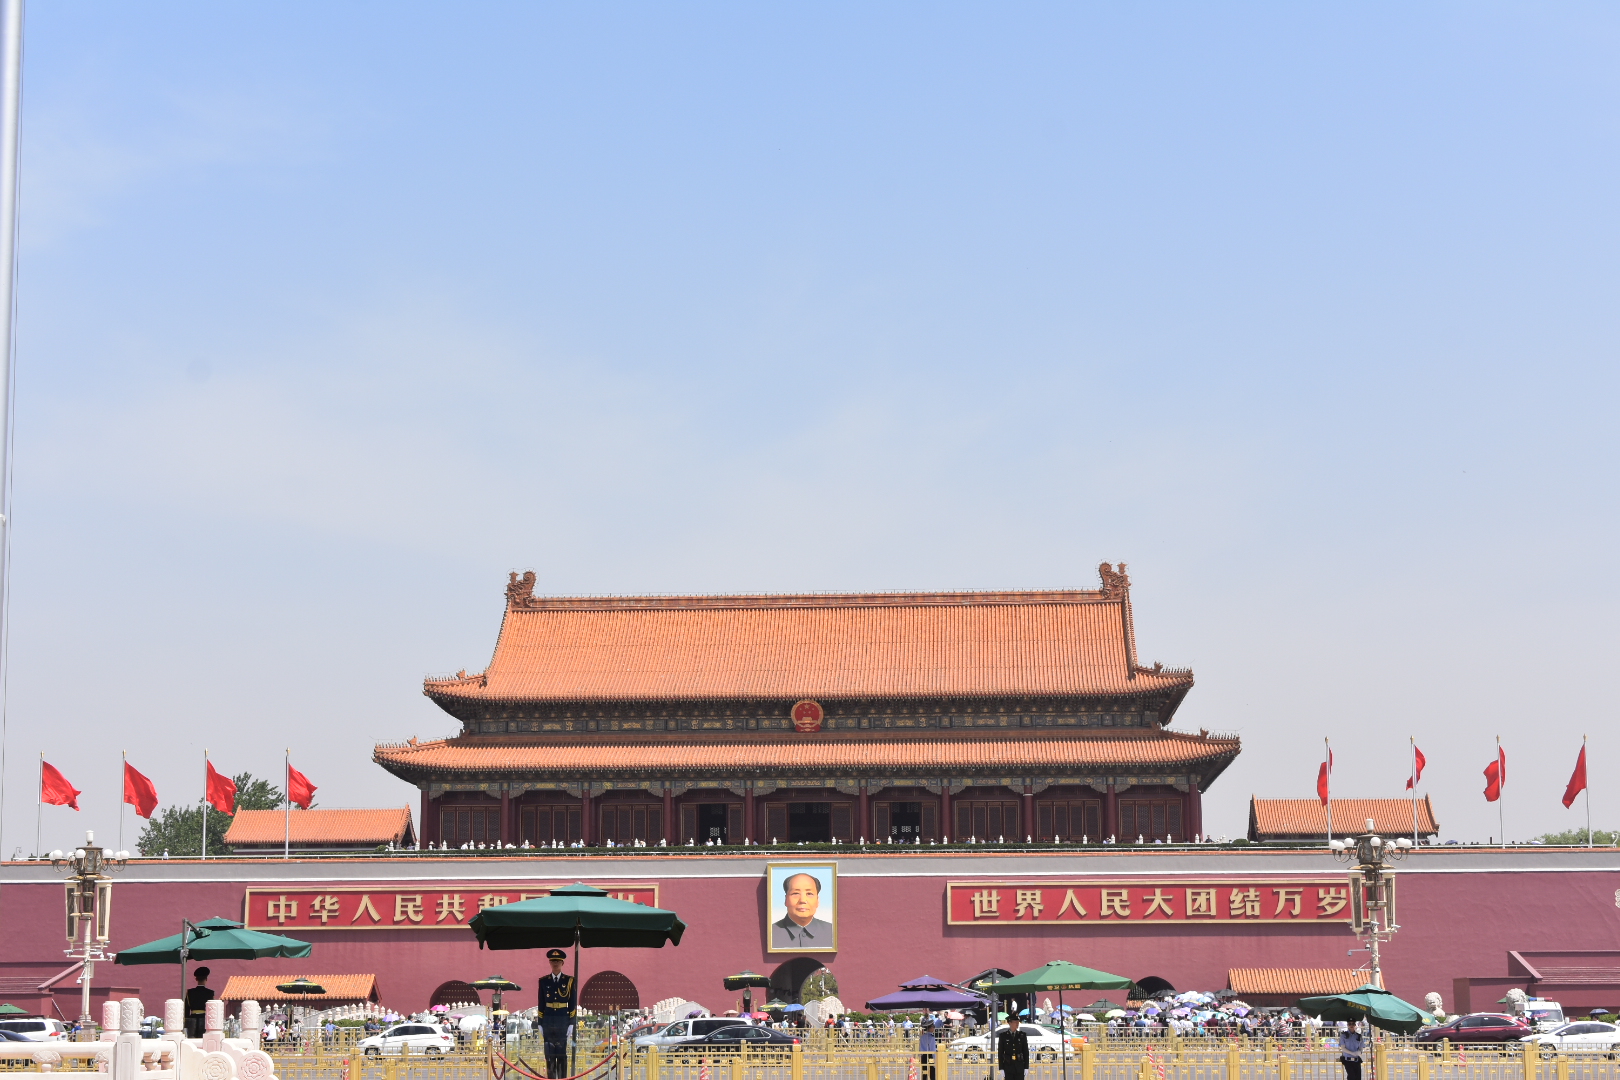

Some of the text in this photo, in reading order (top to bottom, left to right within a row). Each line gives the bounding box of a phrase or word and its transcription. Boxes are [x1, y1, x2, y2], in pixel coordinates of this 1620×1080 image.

[267, 893, 636, 923] 中华人民共和
[971, 887, 1348, 918] 世界人民大团结万岁
